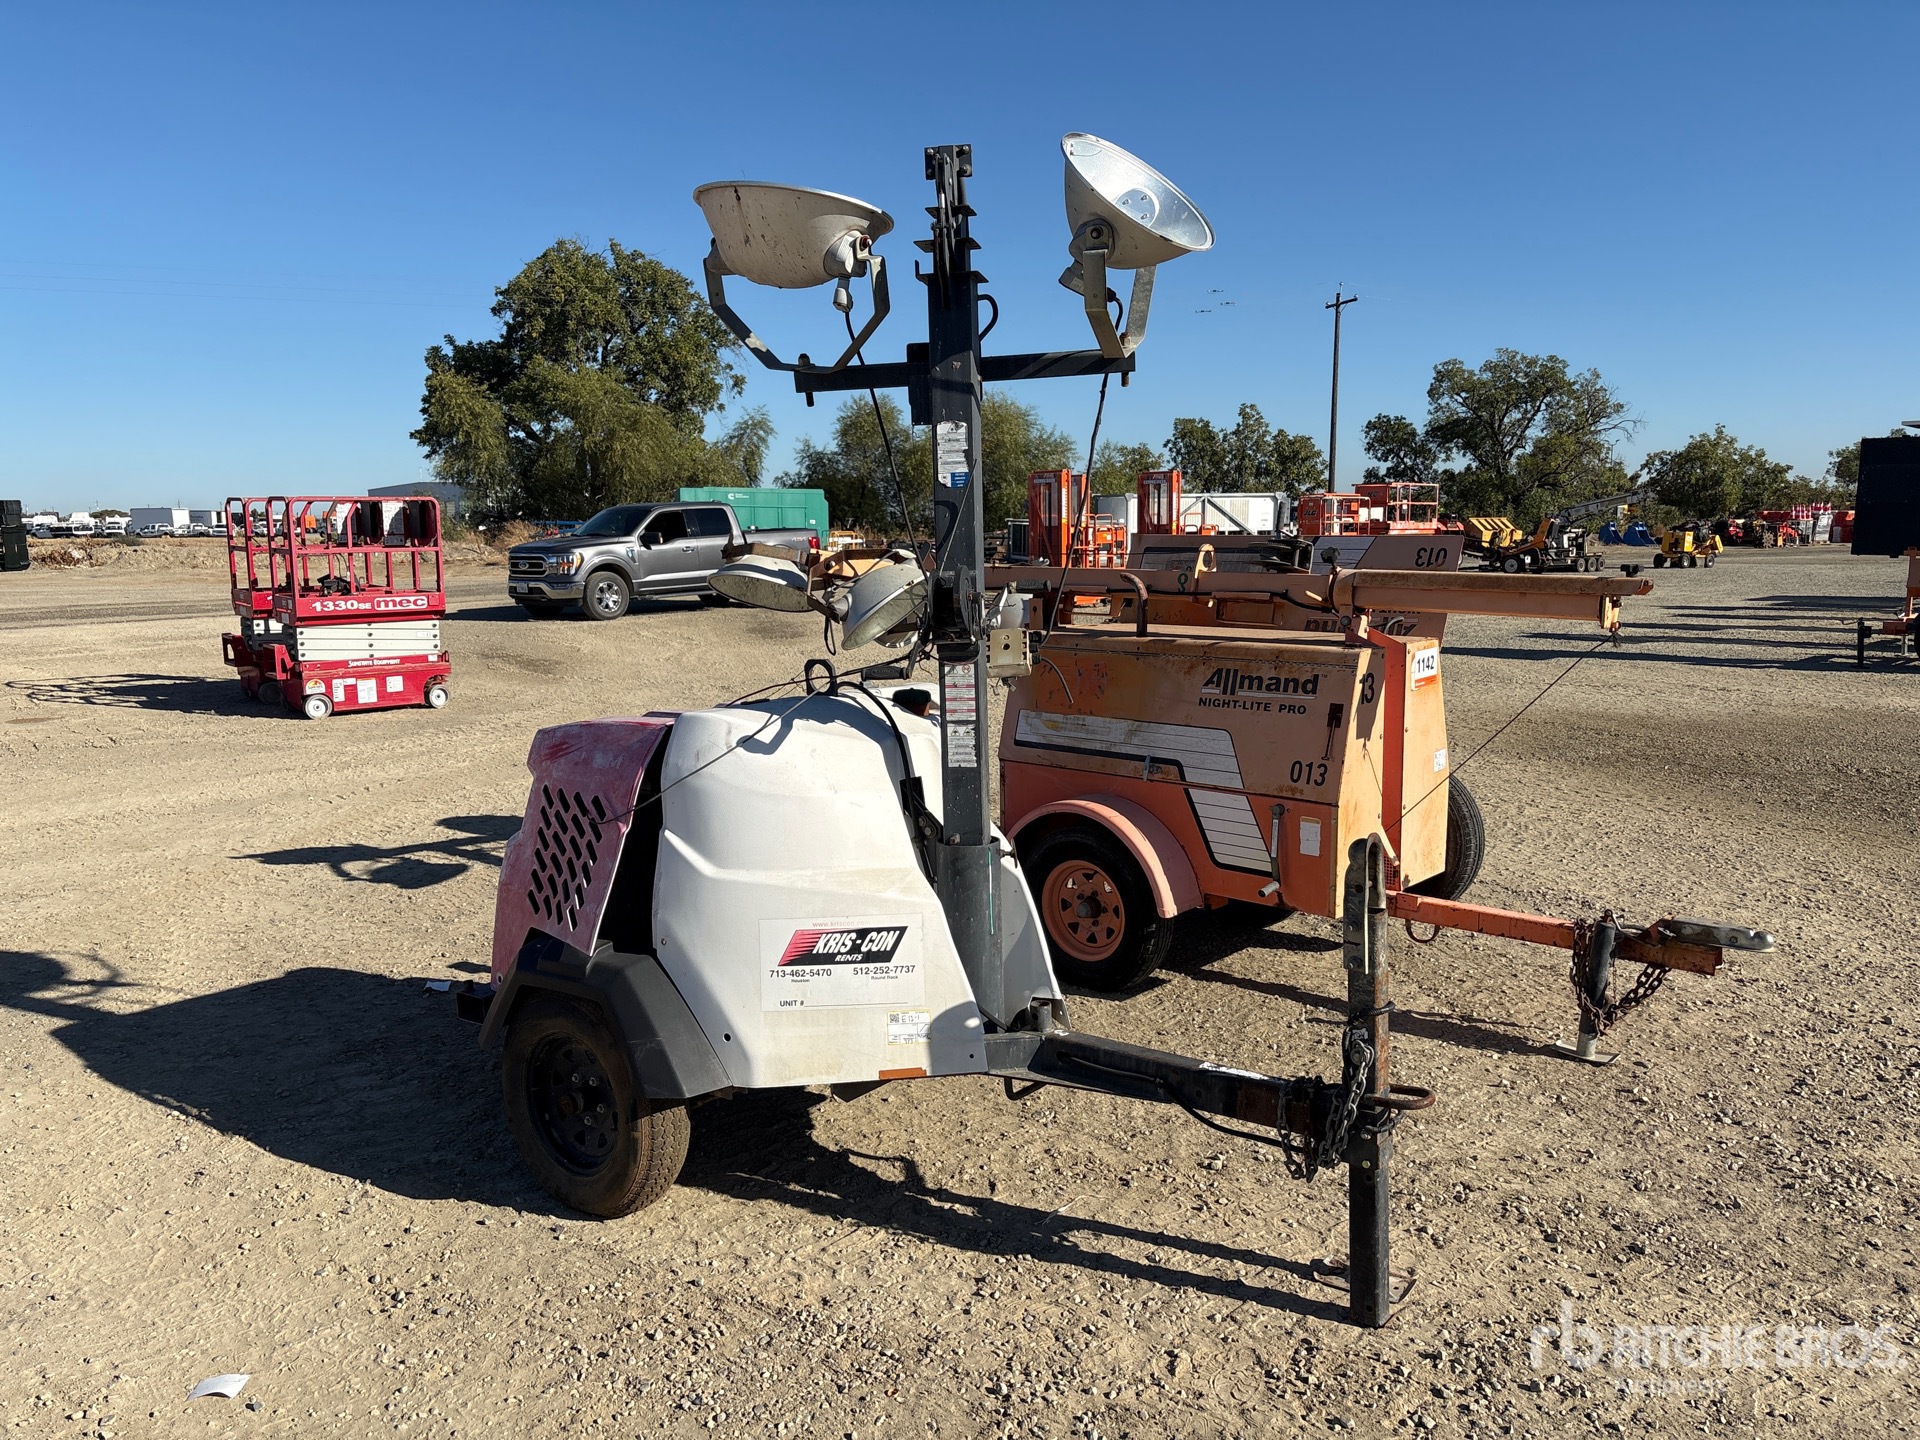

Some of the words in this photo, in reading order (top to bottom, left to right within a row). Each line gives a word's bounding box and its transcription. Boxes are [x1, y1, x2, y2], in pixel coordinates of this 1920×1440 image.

[1415, 547, 1448, 567] 013
[311, 599, 372, 612] 1330SE
[375, 597, 427, 609] mec
[1416, 655, 1435, 673] 1142
[1202, 667, 1320, 696] Allmand
[1198, 697, 1272, 712] NIGHT-LITE
[1278, 703, 1307, 715] PRO
[1289, 760, 1328, 787] 013
[834, 953, 864, 962] RENTS
[769, 968, 832, 978] 713-462-5470
[853, 965, 916, 975] 512-252-7737
